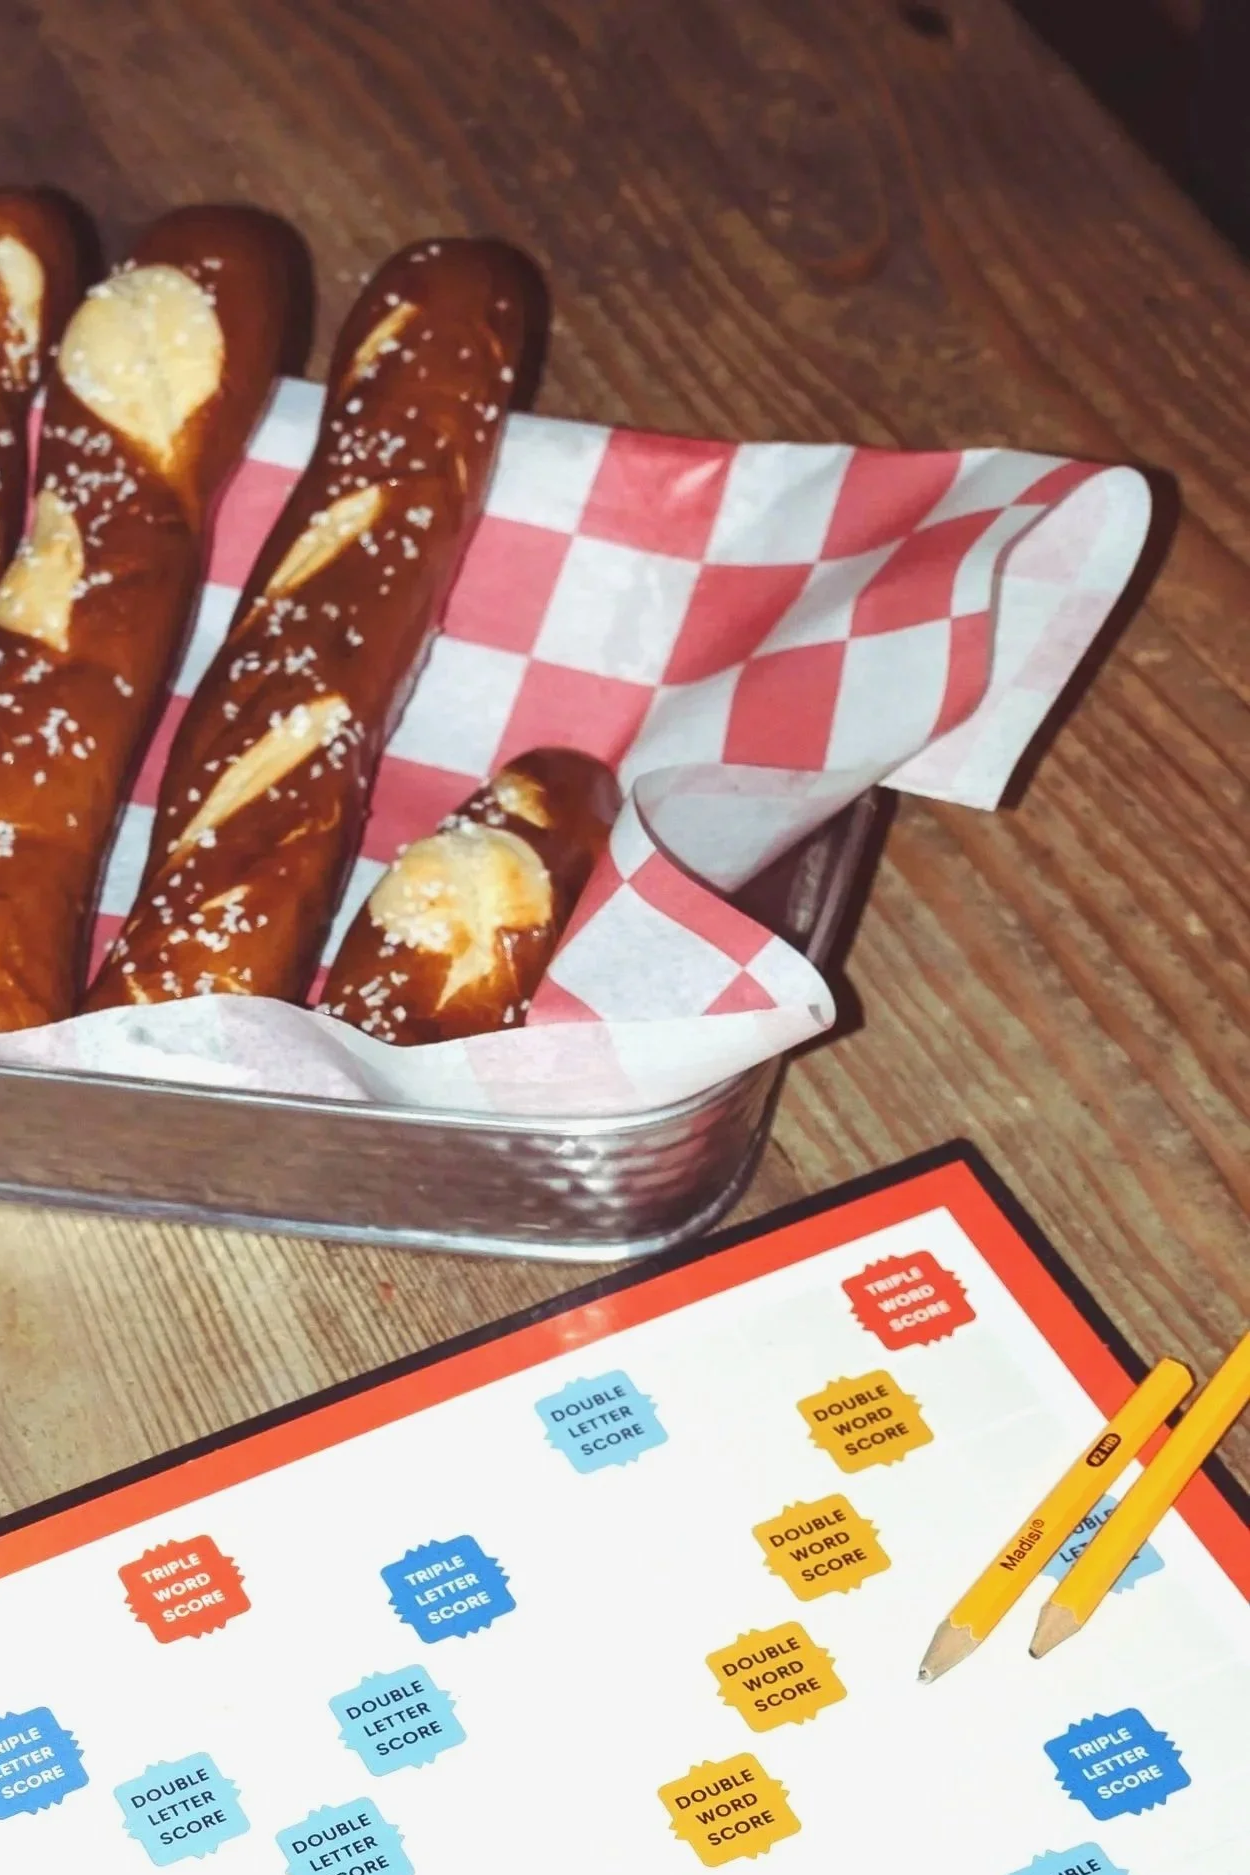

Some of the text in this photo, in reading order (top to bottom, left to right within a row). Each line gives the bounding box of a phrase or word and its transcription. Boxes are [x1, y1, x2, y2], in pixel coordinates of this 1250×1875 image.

[866, 1267, 921, 1294] TRIPLE
[879, 1284, 935, 1313] WORD
[890, 1300, 948, 1331] SCORE
[550, 1385, 625, 1422] DOUBLE
[813, 1384, 889, 1422] DOUBLE
[568, 1406, 632, 1438] LETTER
[832, 1406, 893, 1437] WORD
[581, 1423, 644, 1456] SCORE
[844, 1422, 910, 1456] SCORE
[769, 1508, 847, 1548] DOUBLE
[789, 1531, 850, 1562] WORD
[141, 1552, 201, 1584] TRIPLE
[405, 1555, 464, 1586] TRIPLE
[801, 1548, 867, 1582] SCORE
[152, 1572, 212, 1603] WORD
[416, 1572, 479, 1606] LETTER
[161, 1589, 225, 1623] SCORE
[427, 1591, 490, 1624] SCORE
[345, 1680, 425, 1720] DOUBLE
[363, 1702, 431, 1737] LETTER
[375, 1720, 443, 1756] SCORE
[0, 1764, 64, 1799] SCORE
